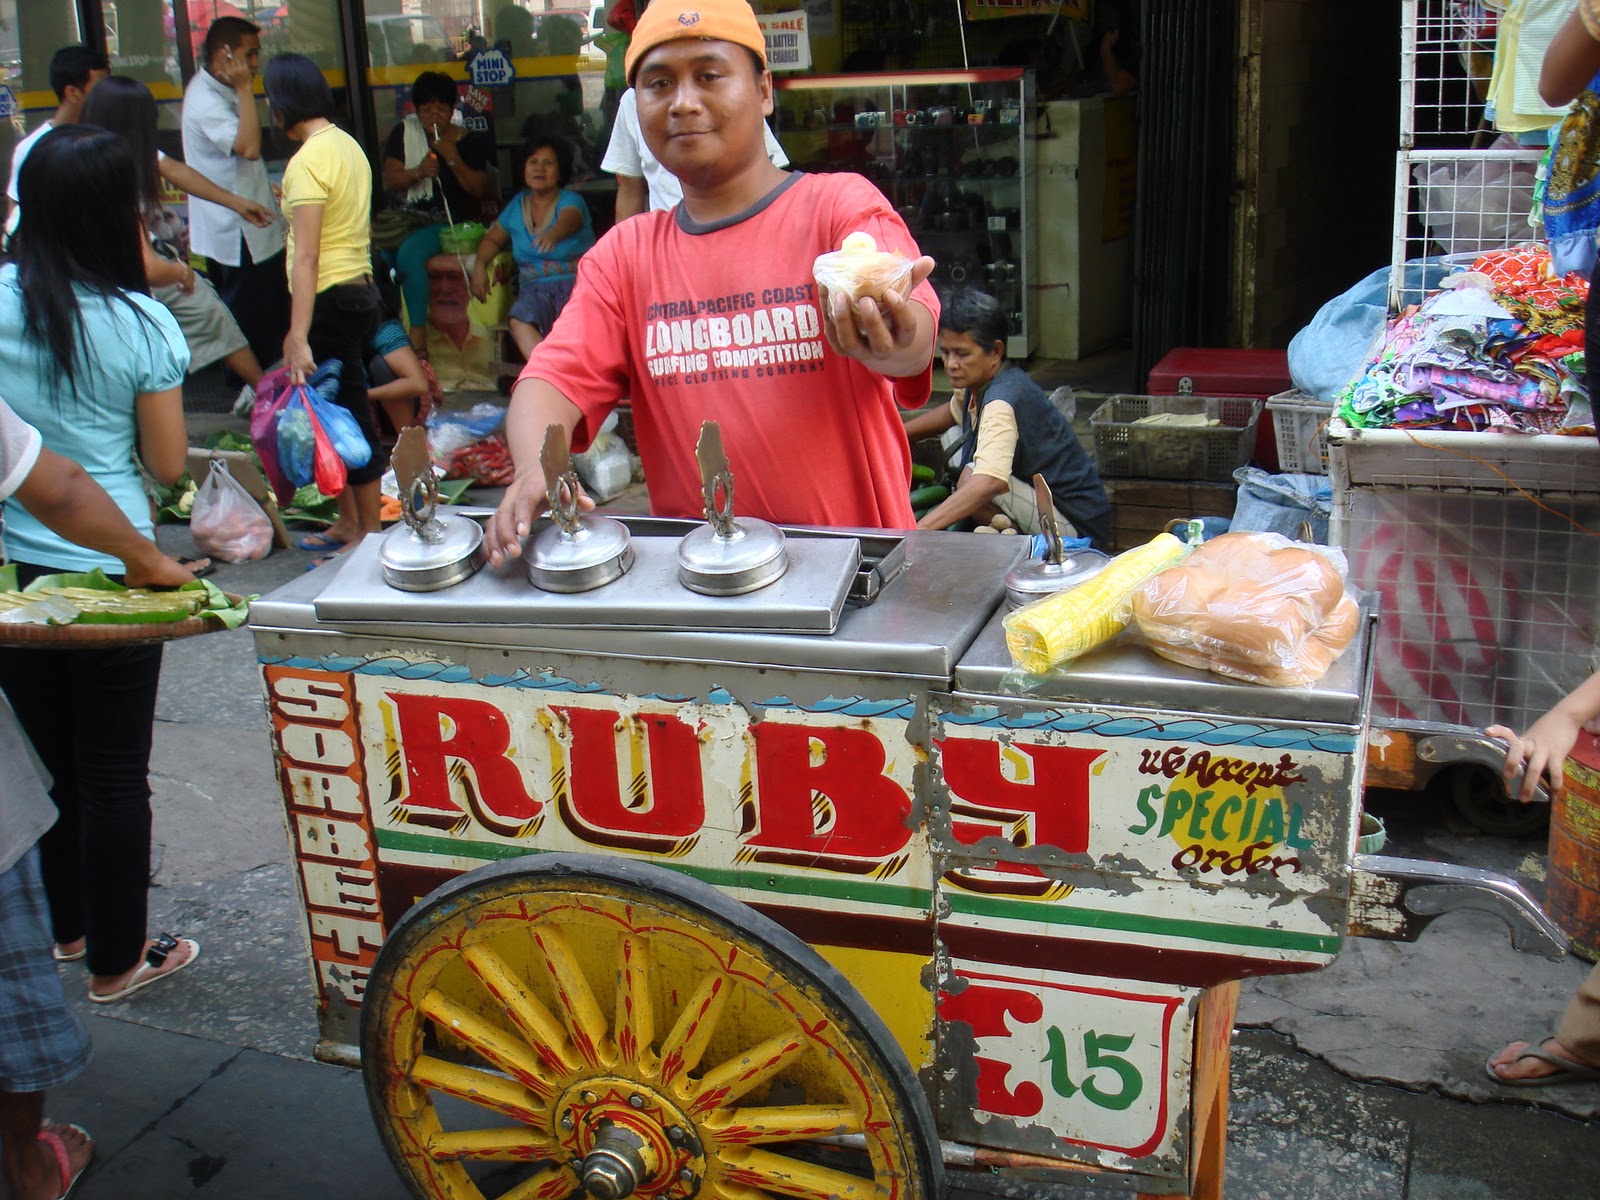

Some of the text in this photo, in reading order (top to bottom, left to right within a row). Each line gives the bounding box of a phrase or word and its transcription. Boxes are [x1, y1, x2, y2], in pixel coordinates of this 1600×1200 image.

[771, 17, 804, 31] SALE
[773, 33, 799, 48] BATTERY
[476, 57, 505, 70] MINI
[773, 48, 800, 63] CHARGER
[476, 70, 507, 83] STOP
[467, 84, 490, 106] SAVE
[647, 283, 815, 321] CNTRAL PACIFIC COAST
[645, 303, 821, 357] LONGBOARD
[647, 340, 825, 377] SURFING COMPETITION
[756, 360, 826, 378] COMPANY
[380, 690, 1108, 882] RUBY
[1184, 750, 1307, 798] Accept
[1128, 783, 1317, 850] SPECIAL
[1040, 1025, 1144, 1111] 15
